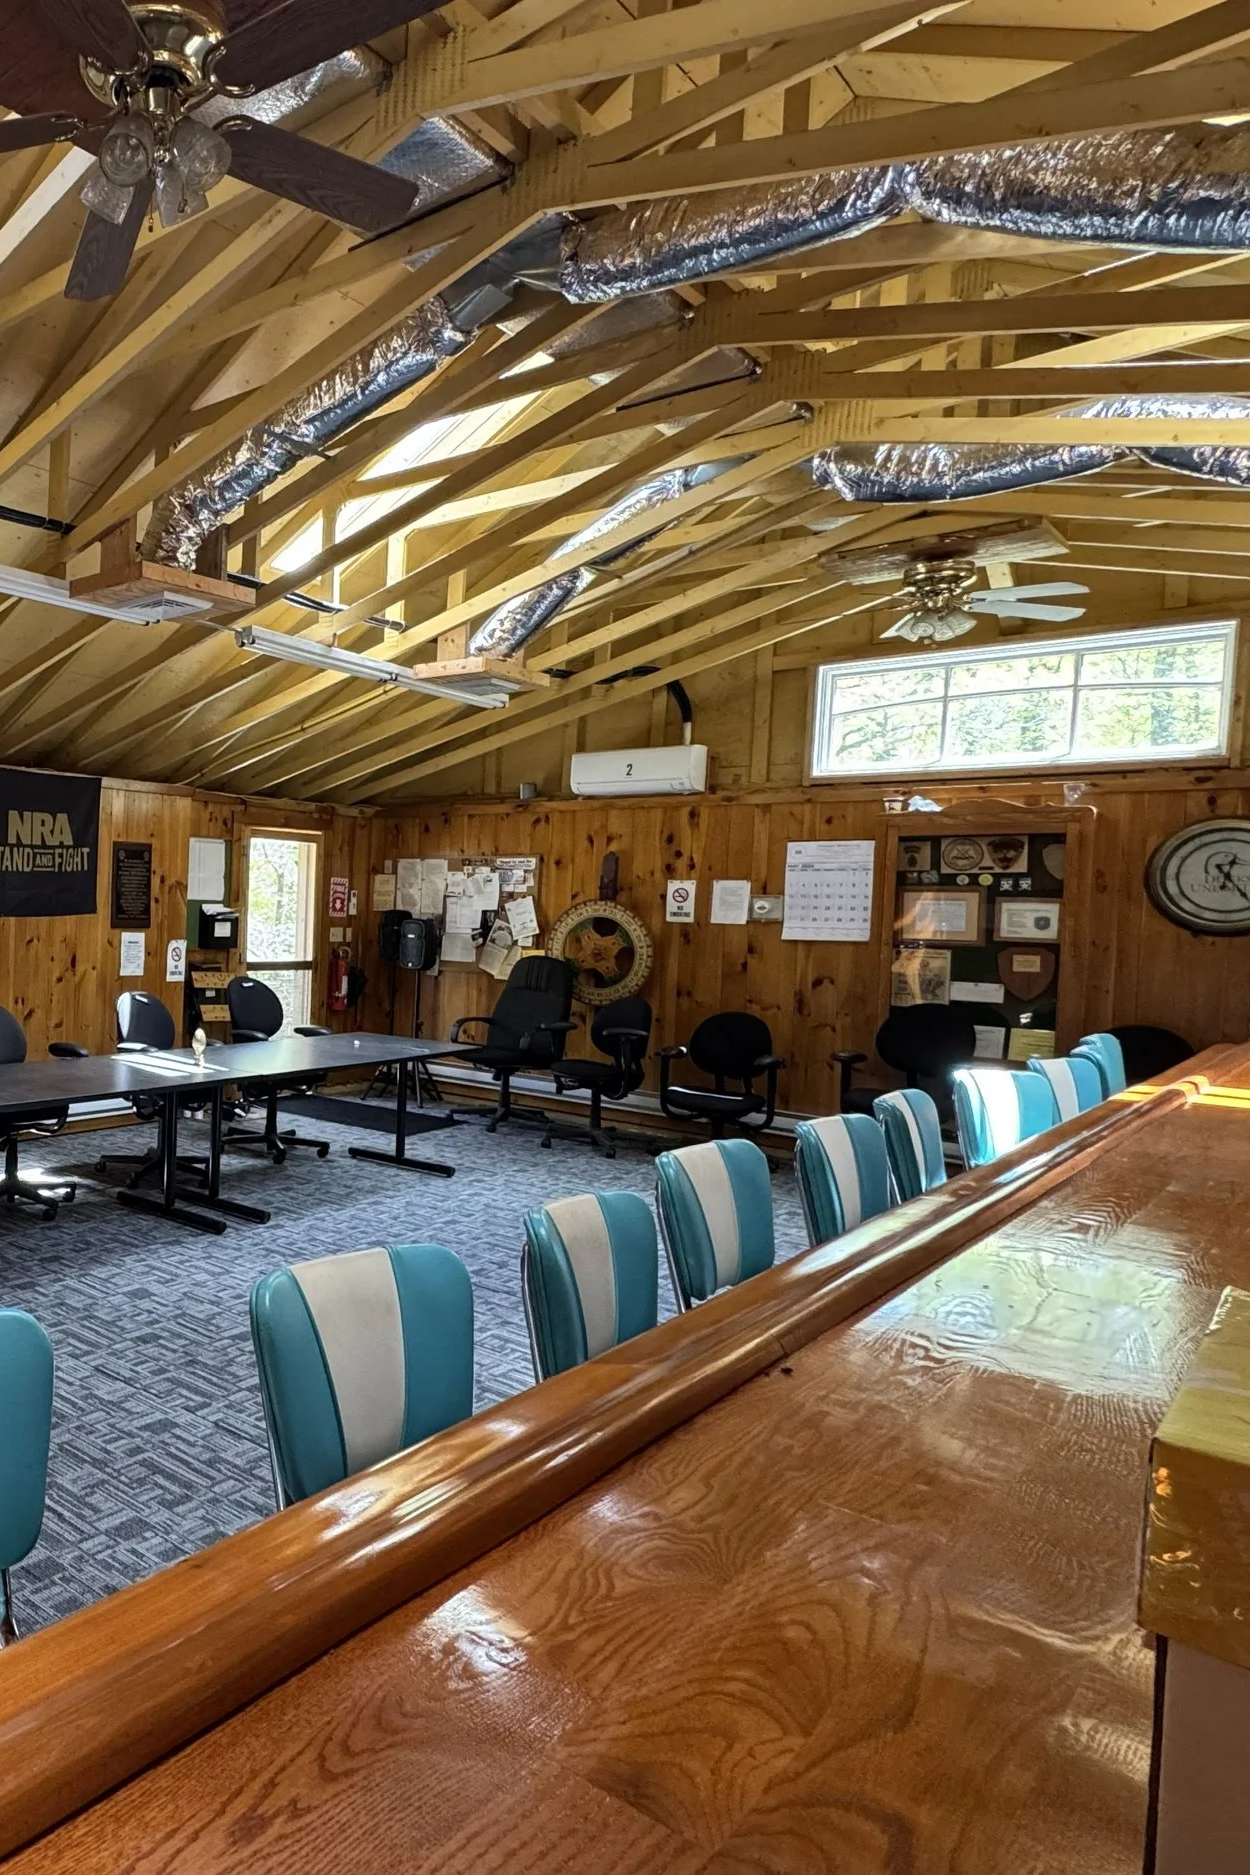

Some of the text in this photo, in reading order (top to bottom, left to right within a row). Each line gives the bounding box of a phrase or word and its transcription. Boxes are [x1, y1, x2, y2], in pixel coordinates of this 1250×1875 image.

[626, 763, 633, 776] 2
[7, 810, 74, 845] NRA
[35, 854, 53, 866] AND
[54, 847, 90, 873] FIGHT
